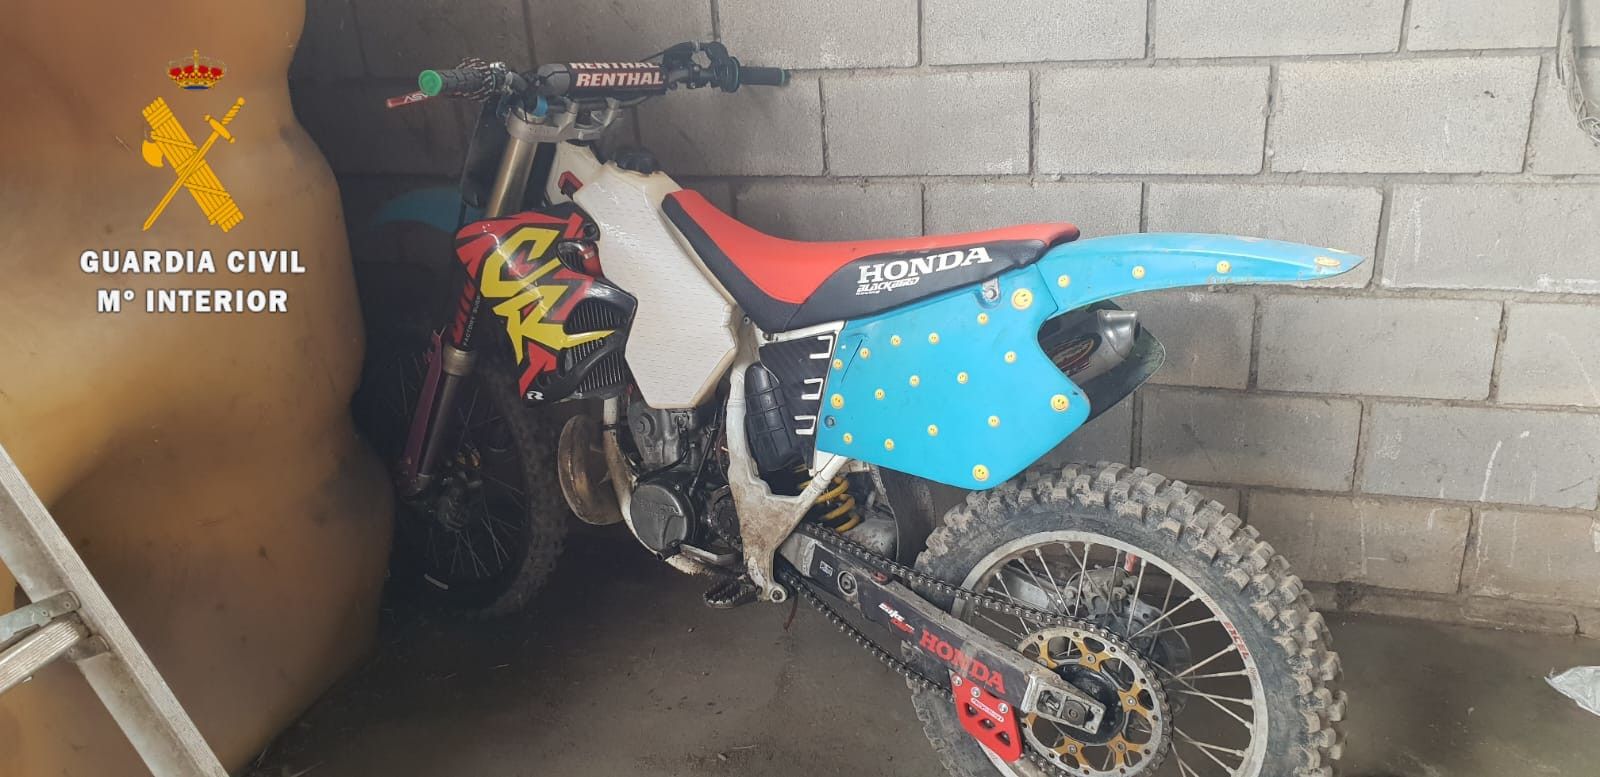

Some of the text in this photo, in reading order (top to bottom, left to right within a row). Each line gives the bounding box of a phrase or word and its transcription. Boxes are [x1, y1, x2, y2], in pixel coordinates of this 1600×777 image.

[575, 72, 664, 87] RENTHAL
[857, 247, 993, 284] HONDA
[919, 628, 1006, 694] HONDA
